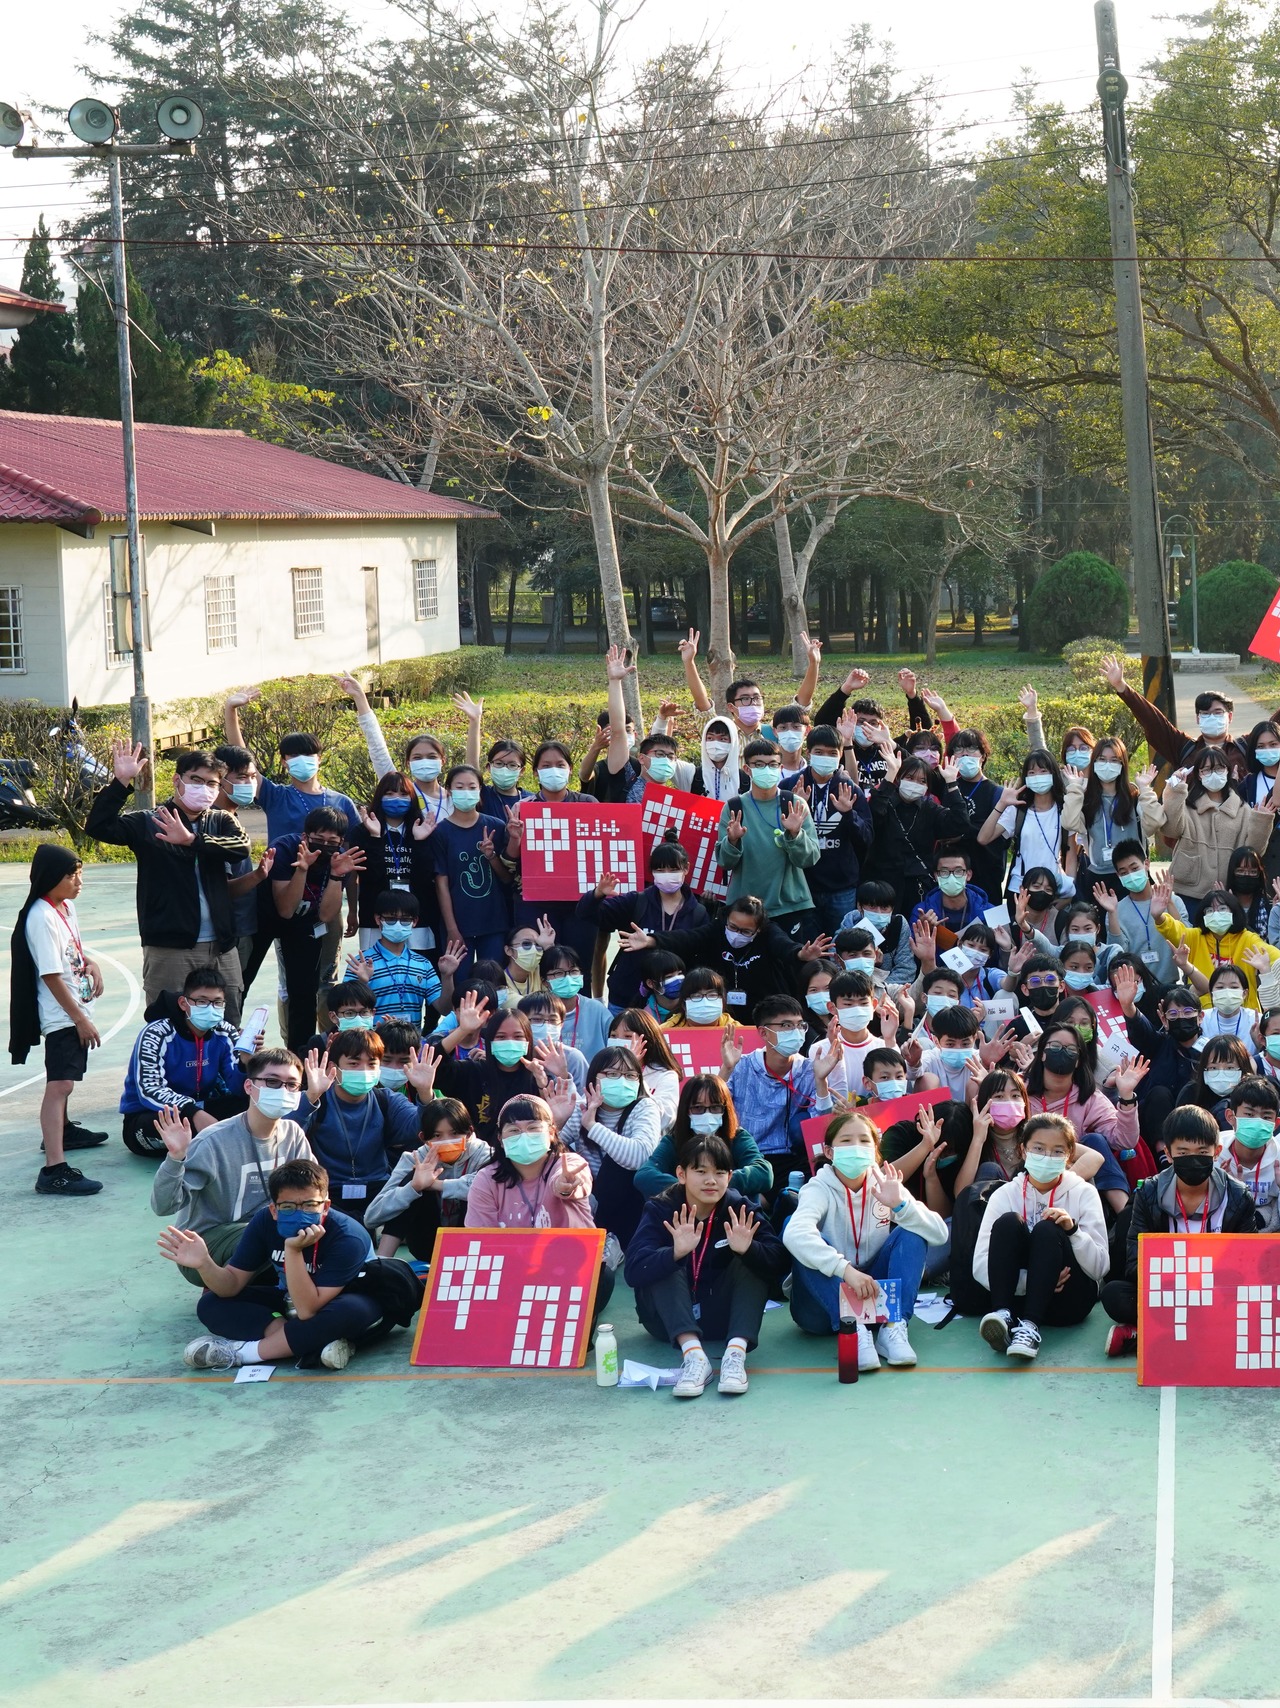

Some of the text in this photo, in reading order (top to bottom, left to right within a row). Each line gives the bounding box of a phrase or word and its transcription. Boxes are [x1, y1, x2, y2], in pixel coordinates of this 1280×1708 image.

[525, 807, 570, 872] 中
[576, 840, 637, 894] 09
[437, 1240, 504, 1331] 中
[509, 1285, 583, 1367] 01
[1148, 1240, 1213, 1342] 中
